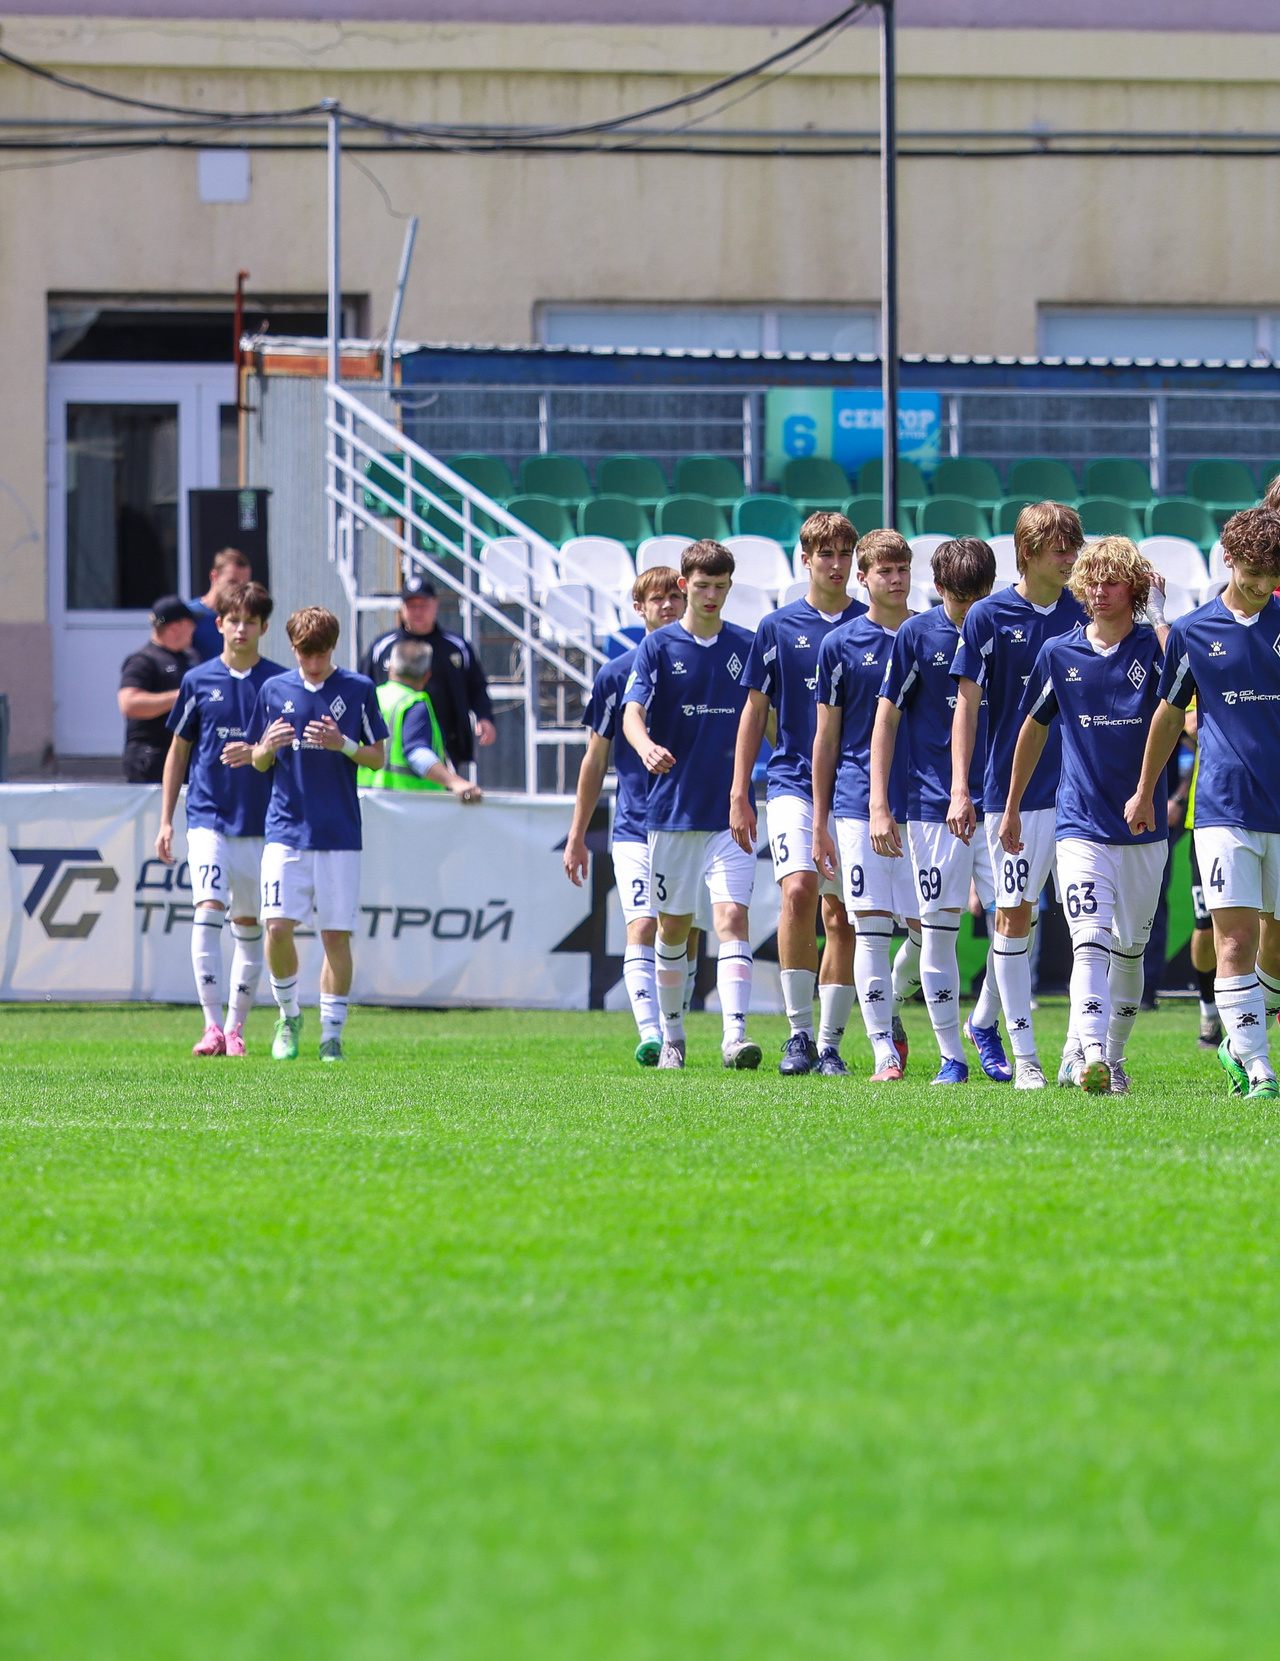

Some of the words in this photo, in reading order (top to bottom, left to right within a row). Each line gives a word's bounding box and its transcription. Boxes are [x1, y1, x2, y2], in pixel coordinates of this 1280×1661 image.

[783, 413, 818, 458] 6
[771, 832, 790, 867] 13
[199, 864, 221, 891] 72
[632, 878, 645, 907] 2
[655, 872, 667, 902] 3
[850, 864, 865, 898] 9
[918, 866, 942, 902] 69
[1004, 858, 1030, 894] 88
[1210, 857, 1225, 893] 4
[263, 880, 282, 908] 11
[1066, 881, 1098, 919] 63
